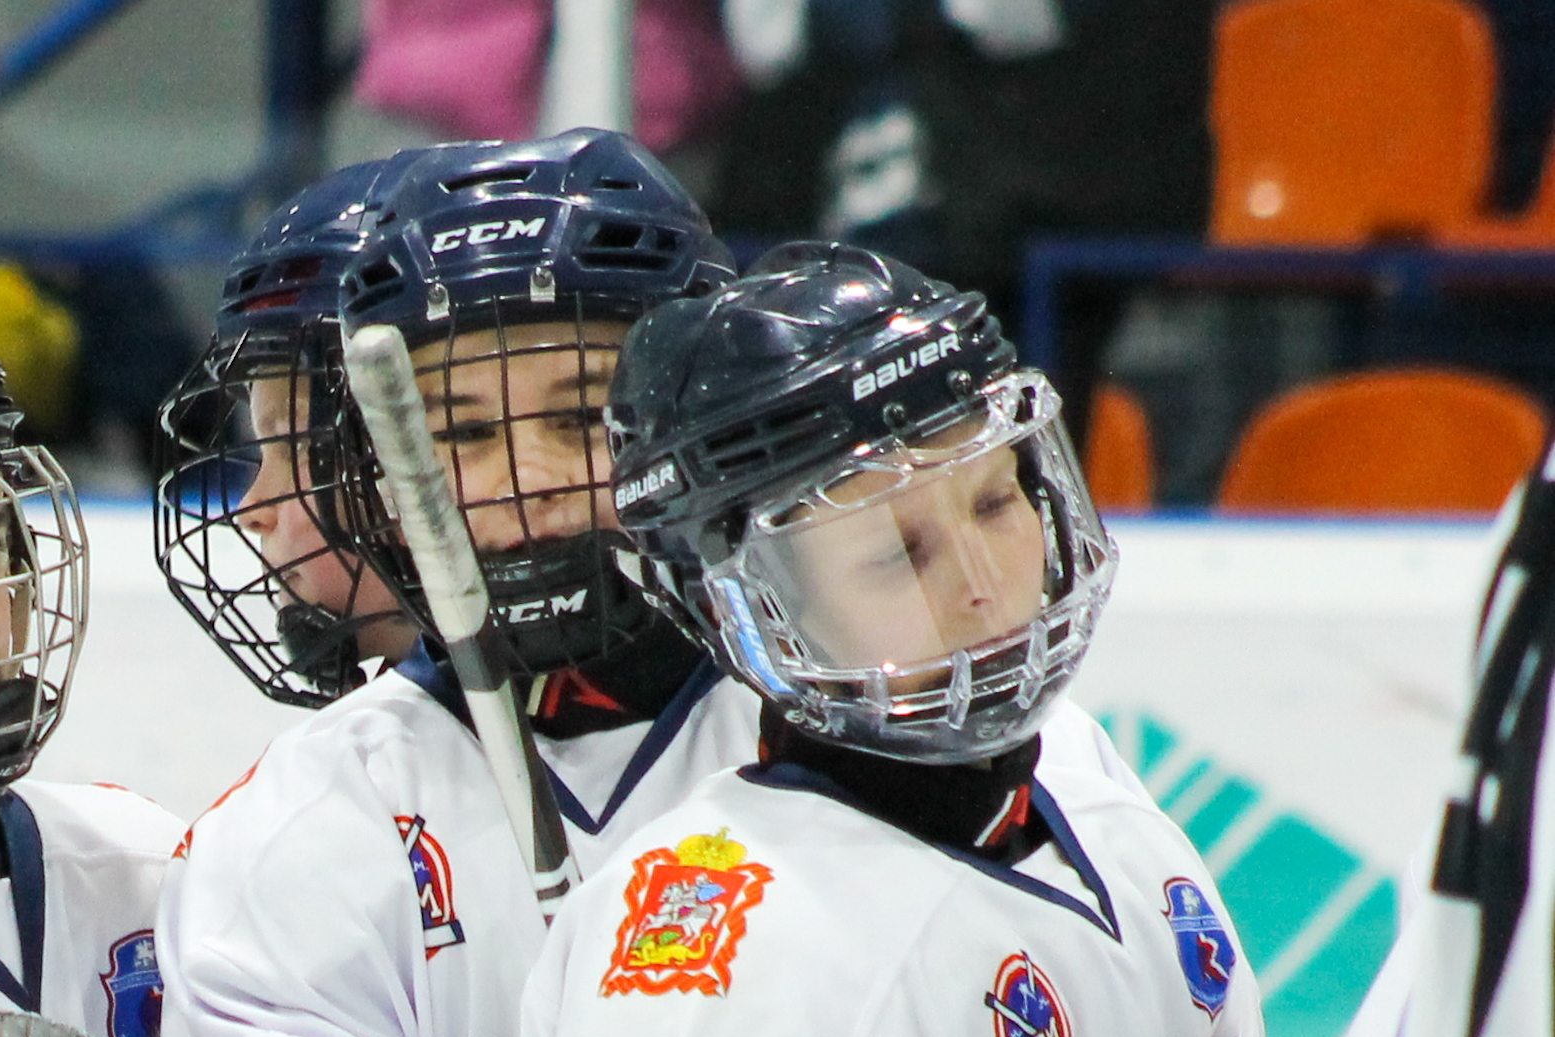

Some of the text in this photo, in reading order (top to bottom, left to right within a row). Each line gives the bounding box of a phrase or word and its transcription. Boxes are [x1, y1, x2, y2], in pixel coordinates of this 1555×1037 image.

[431, 216, 546, 254] CCM
[852, 332, 962, 402] BAUER
[615, 464, 676, 510] BAUER
